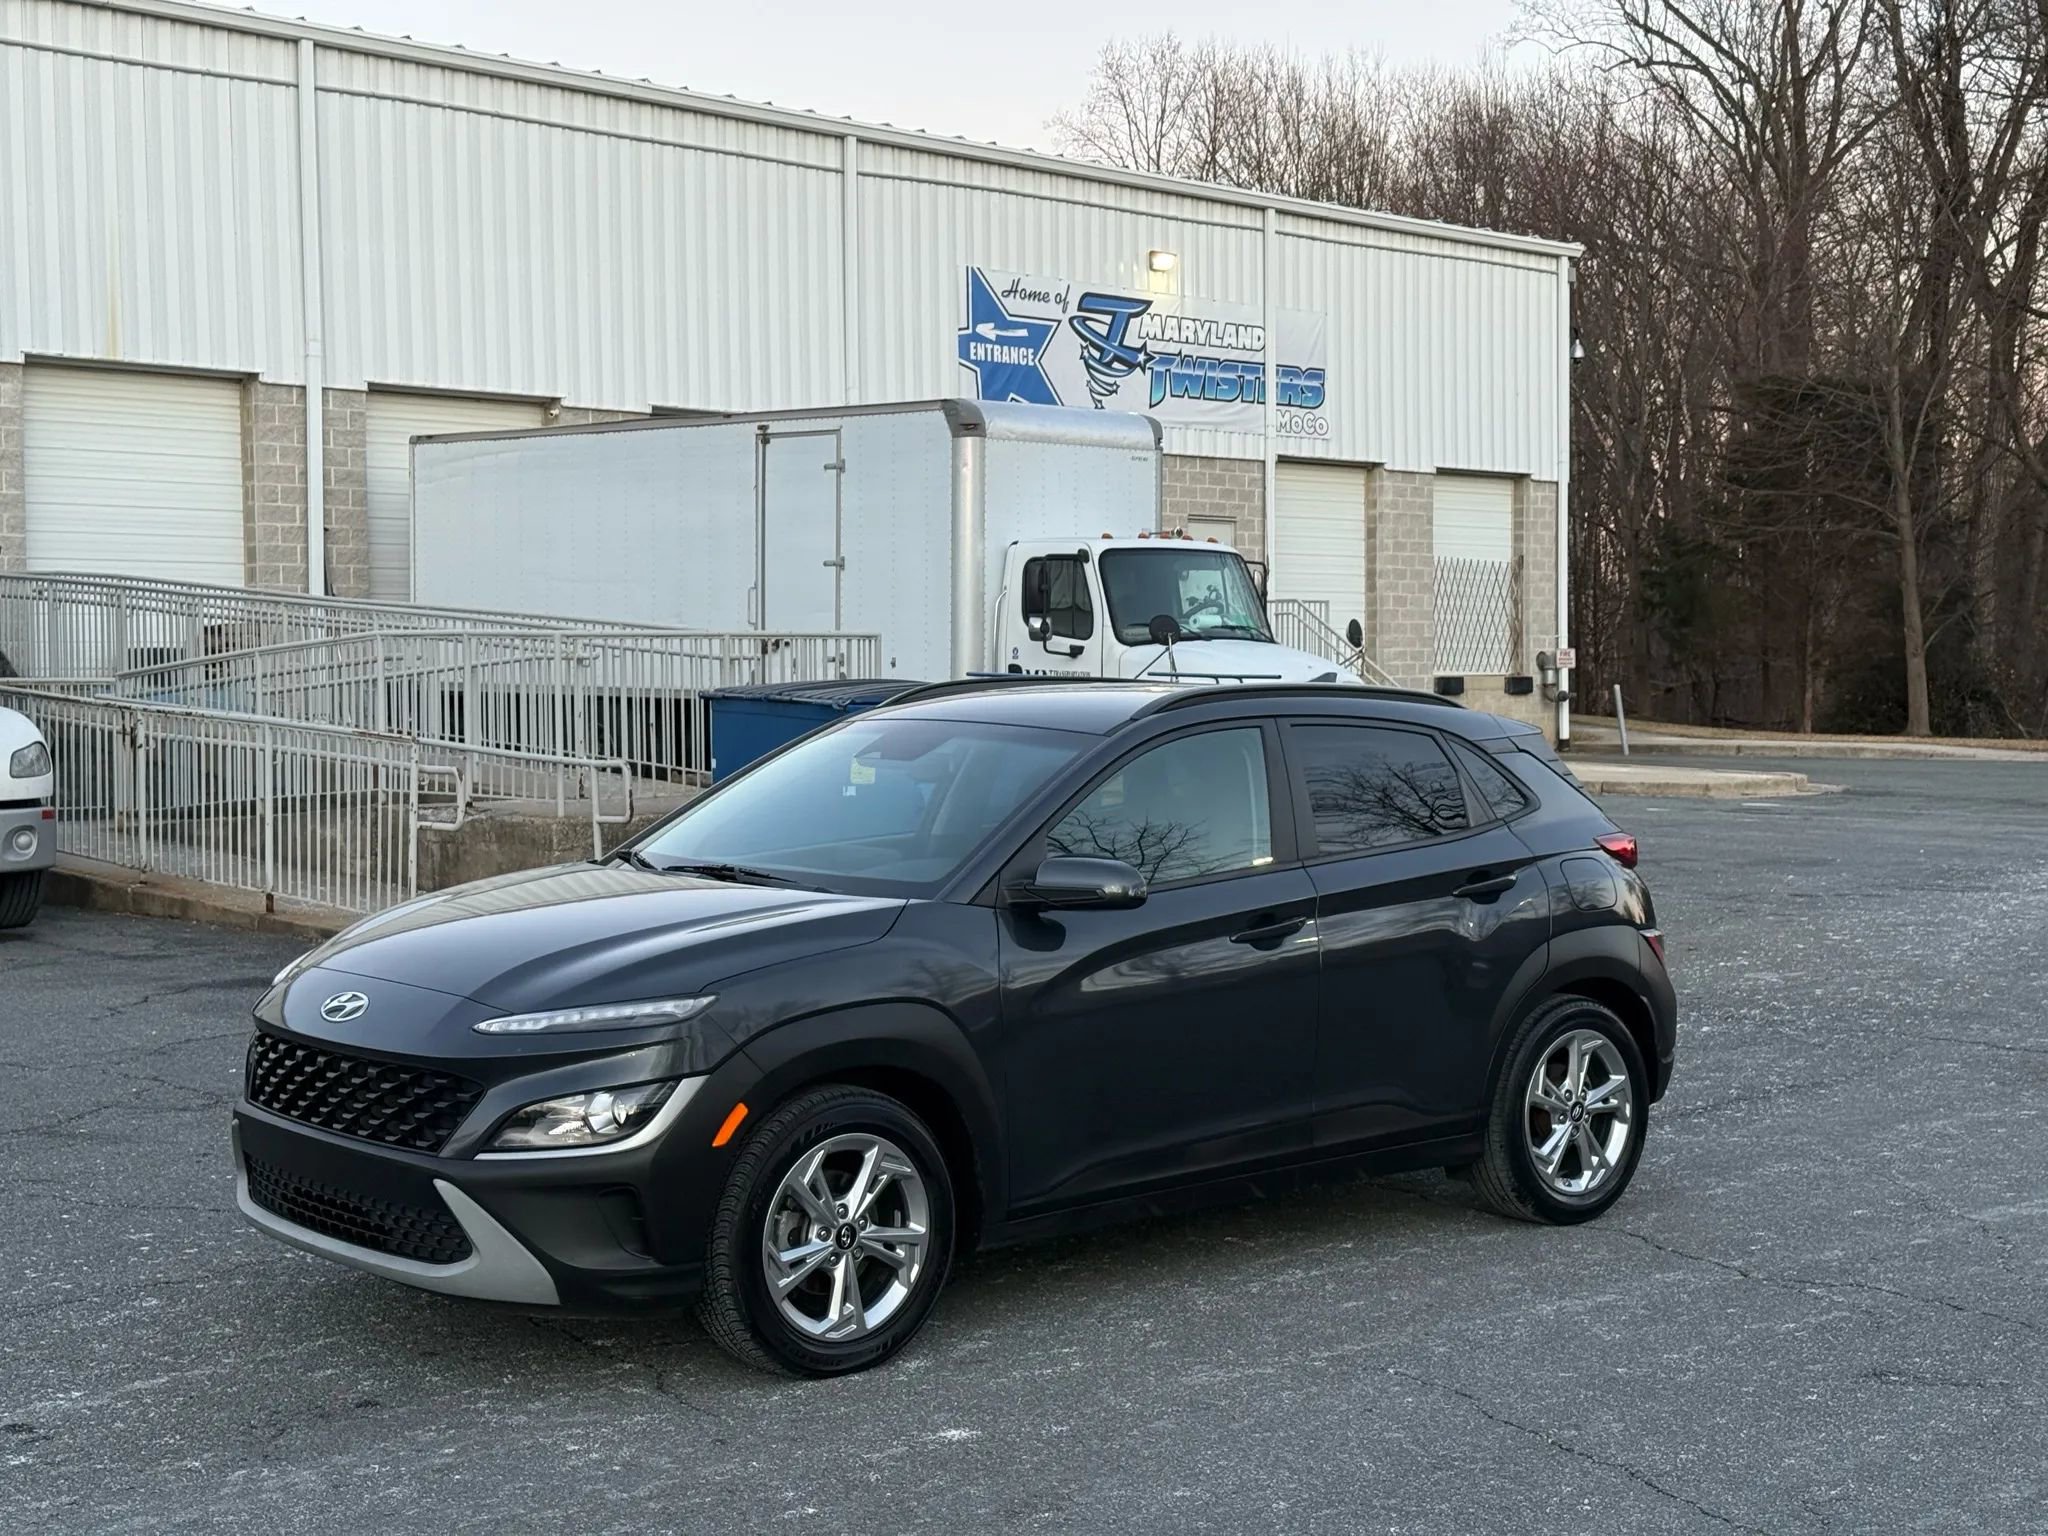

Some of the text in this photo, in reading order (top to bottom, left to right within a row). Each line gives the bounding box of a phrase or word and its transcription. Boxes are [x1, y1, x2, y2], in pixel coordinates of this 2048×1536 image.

[1001, 278, 1070, 314] Home of
[1138, 313, 1266, 352] MARYLAND
[970, 342, 1035, 366] ENTRANCE
[1147, 349, 1326, 409] TWISTRS
